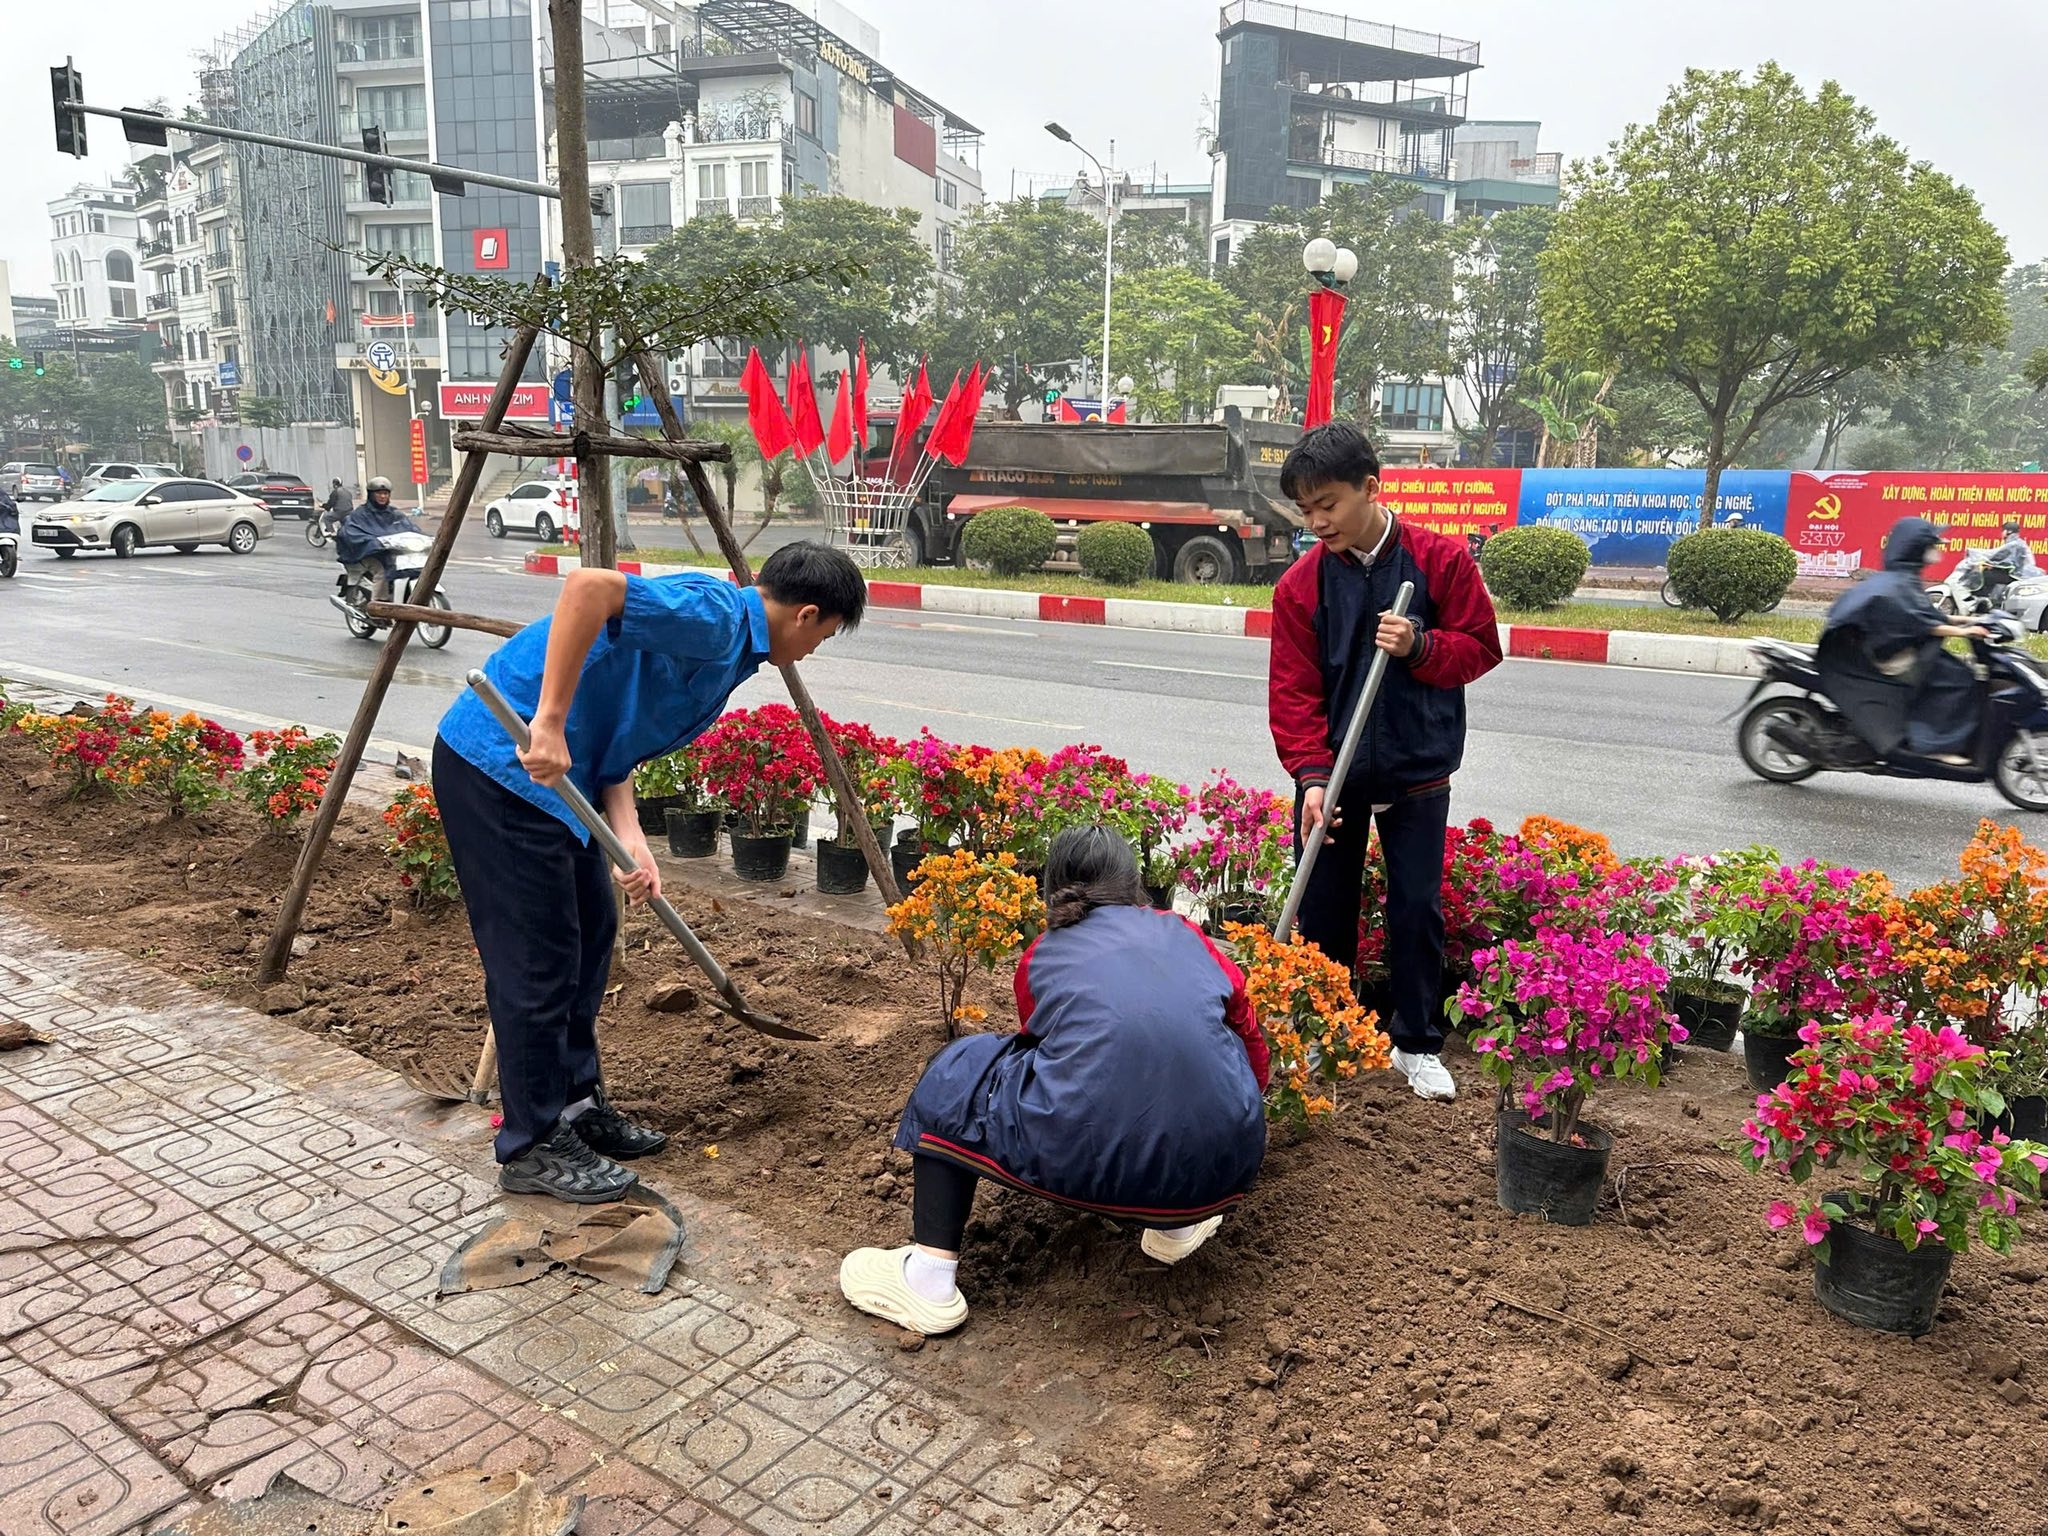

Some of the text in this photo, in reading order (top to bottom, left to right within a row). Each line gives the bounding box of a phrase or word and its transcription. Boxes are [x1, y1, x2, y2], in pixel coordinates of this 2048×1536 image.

[820, 41, 847, 71] AUTO
[454, 393, 480, 404] ANH
[513, 394, 533, 404] ZIM
[1384, 478, 1399, 493] CHỦ
[1402, 480, 1425, 493] CHIẾN
[1426, 481, 1450, 496] LƯỢC,
[1452, 481, 1464, 496] TỰ
[1464, 480, 1495, 495] CƯỜNG,
[1882, 484, 2048, 504] XÂY DỰNG, HOÀN THIỆN NHÀ NƯỚC PH
[1546, 488, 1755, 513] ĐỘT PHÁ PHÁT TRIỂN KHOA HỌC, CG NGHỆ,
[1405, 502, 1430, 516] MẠNH
[1432, 502, 1458, 514] TRONG
[1473, 502, 1508, 516] NGUYÊN
[1573, 516, 1598, 532] SÁNG
[1602, 519, 1618, 536] TẠO
[1621, 516, 1632, 534] VÀ
[1635, 516, 1673, 535] CHUYỂN
[1676, 516, 1692, 534] ĐỔI
[1934, 510, 1950, 526] HỘI
[1951, 508, 1970, 526] CHỦ
[1972, 510, 2000, 528] NGHĨA
[2023, 514, 2046, 528] NAM
[1442, 520, 1460, 535] DÂN
[1808, 524, 1839, 532] ĐẠI HỘI
[1800, 531, 1845, 546] XIV
[1950, 538, 1964, 552] DO
